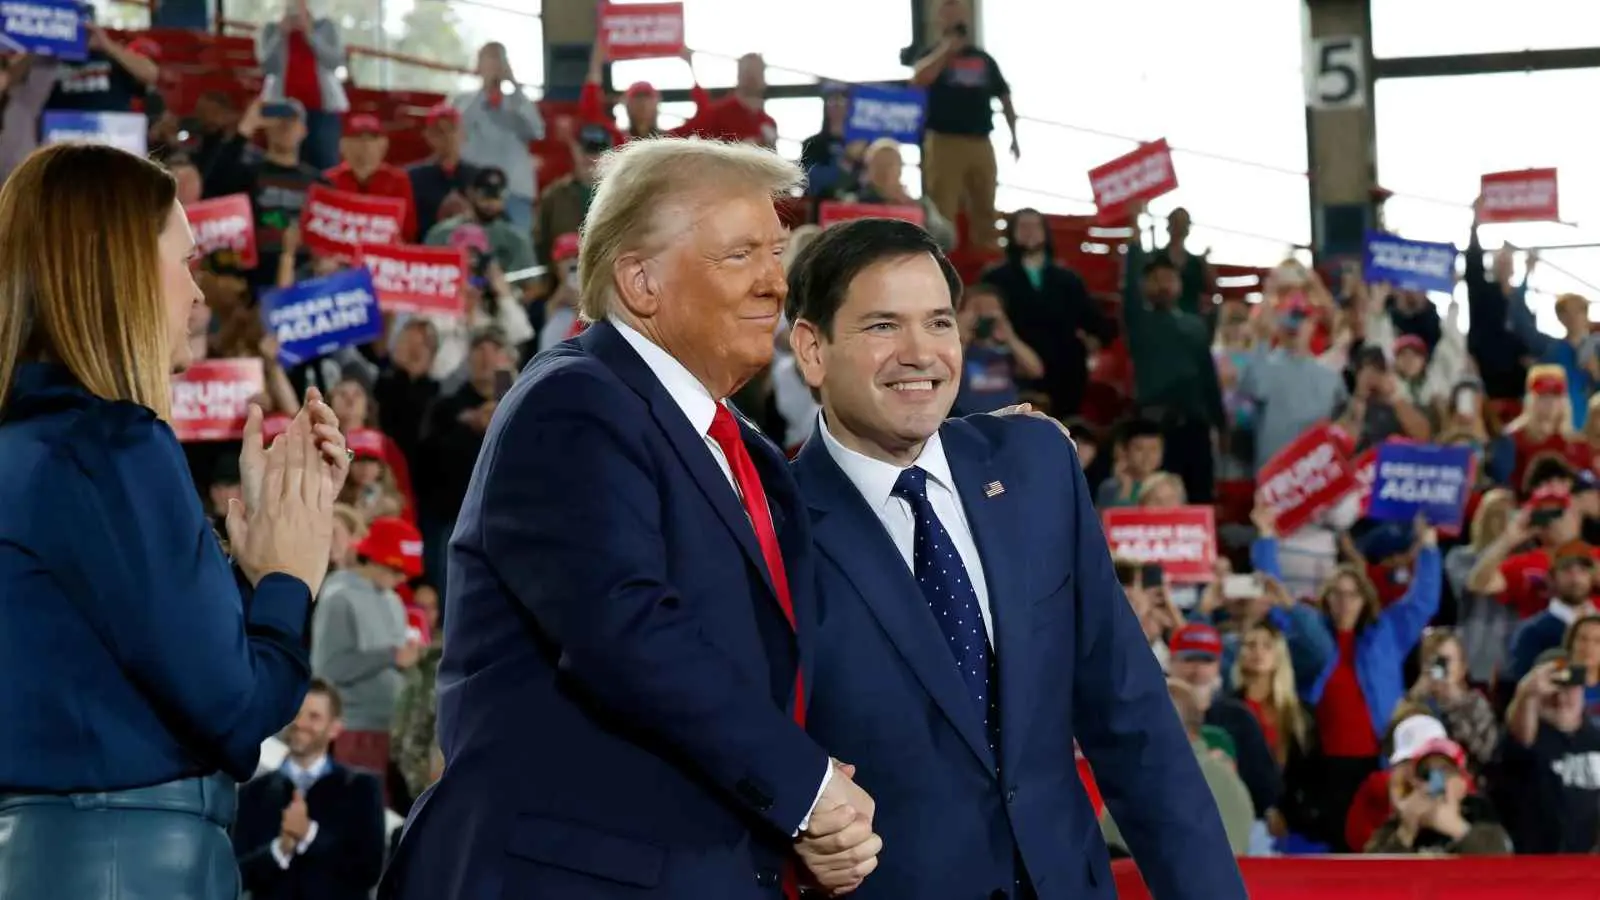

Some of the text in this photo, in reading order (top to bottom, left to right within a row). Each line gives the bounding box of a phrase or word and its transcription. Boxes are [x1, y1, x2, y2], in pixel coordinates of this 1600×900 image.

[1320, 43, 1356, 102] 5
[363, 254, 460, 283] TRUMP
[277, 304, 368, 342] AGAIN!
